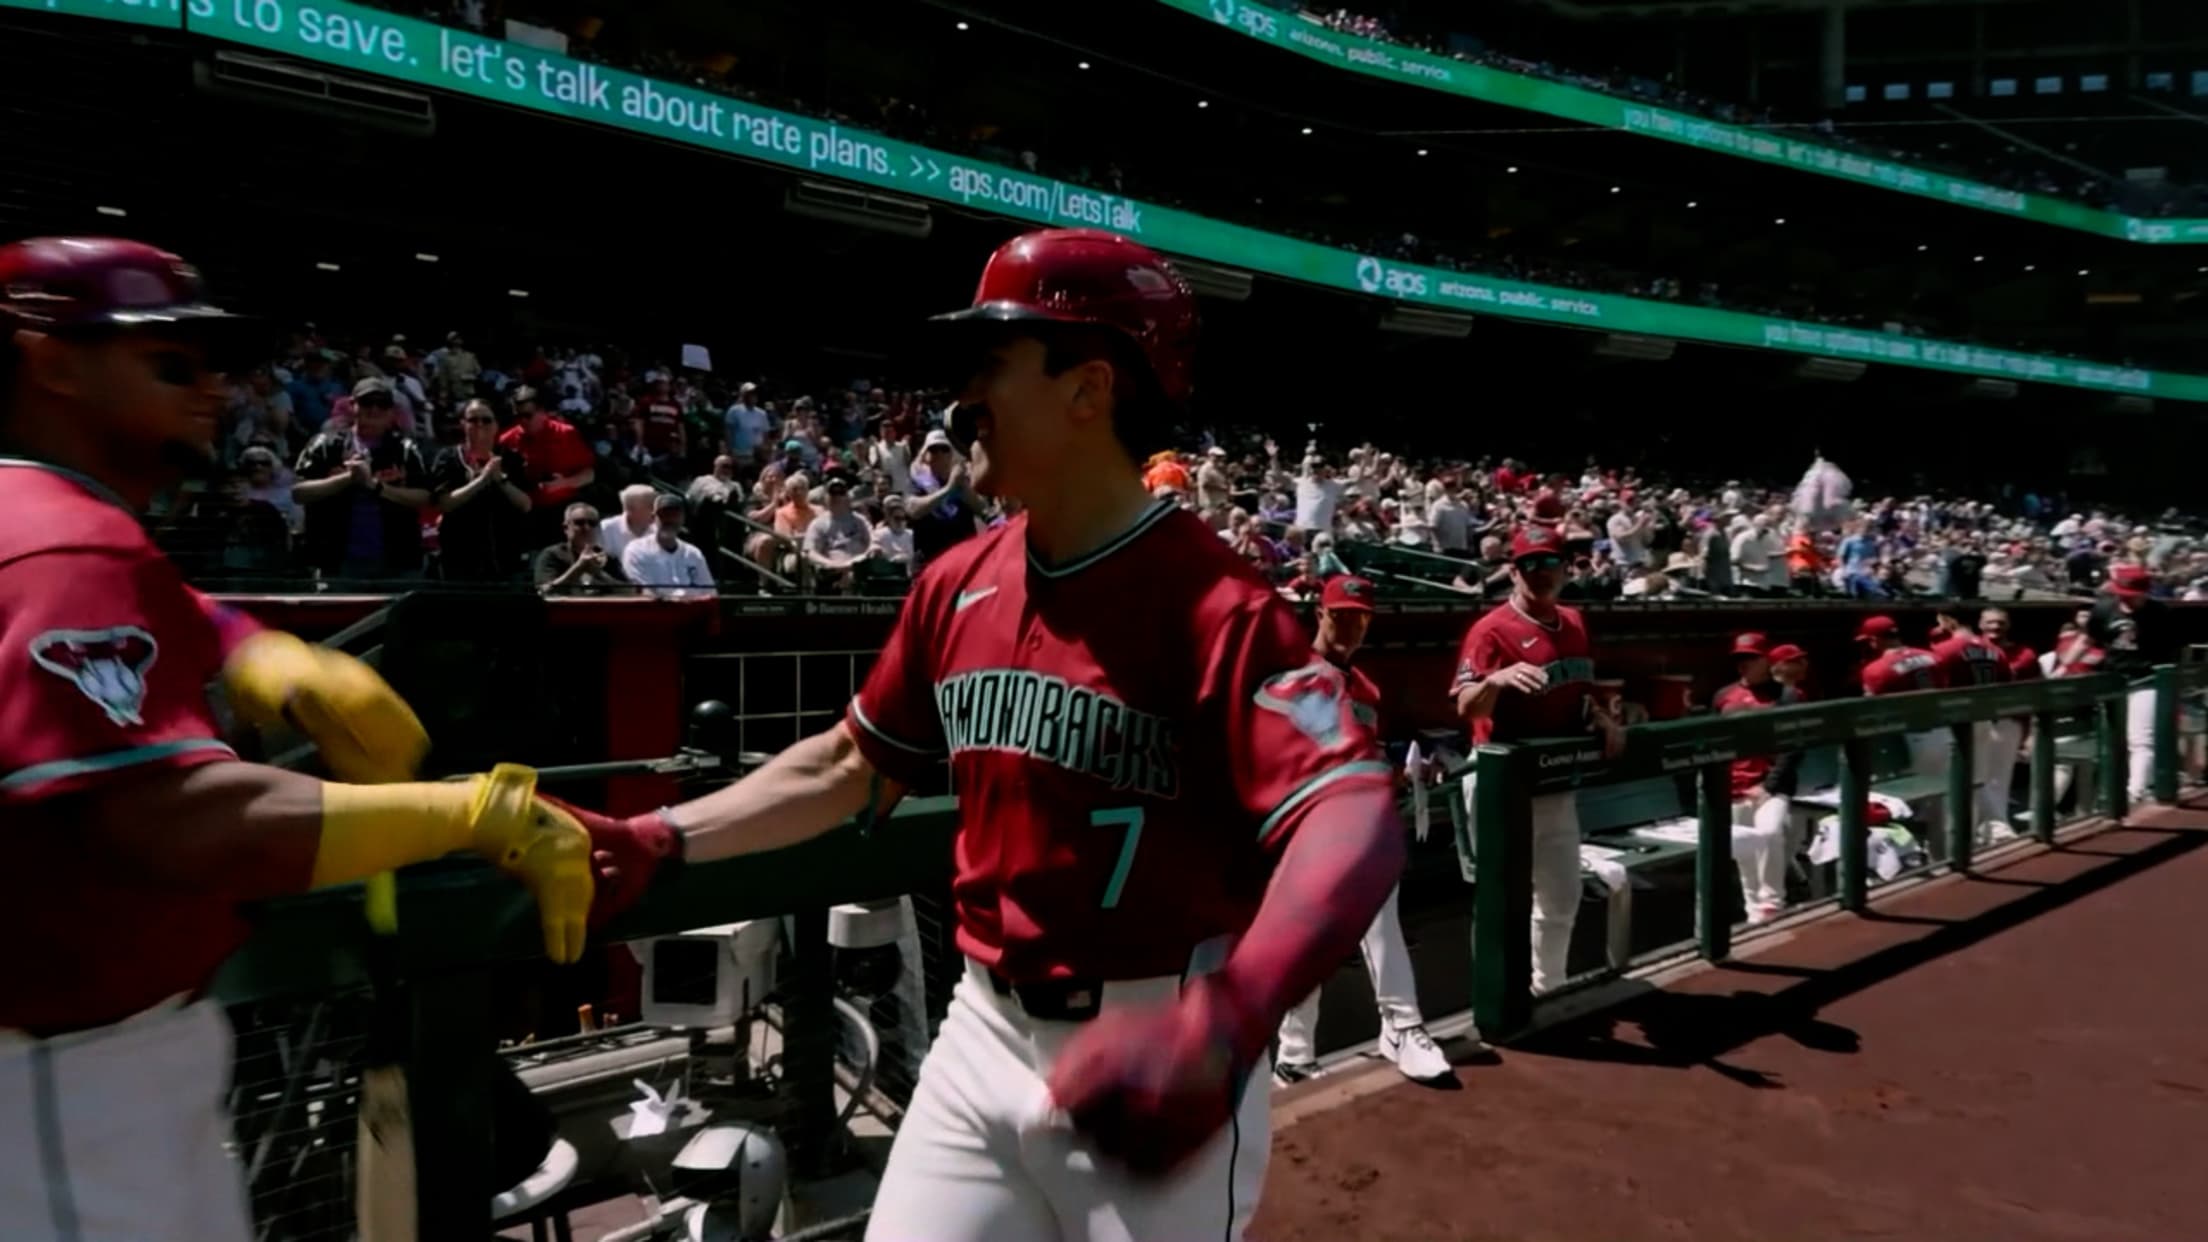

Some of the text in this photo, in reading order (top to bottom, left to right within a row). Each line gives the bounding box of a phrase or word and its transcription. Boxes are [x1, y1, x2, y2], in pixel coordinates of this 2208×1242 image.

[1237, 5, 1278, 38] aps
[298, 7, 418, 67] save.
[440, 28, 527, 90] let's
[536, 58, 612, 111] talk
[621, 78, 724, 137] about
[732, 110, 801, 154] rate
[809, 129, 897, 177] plans.
[949, 164, 1142, 234] aps.com/LetsTalk
[1385, 267, 1428, 298] aps
[1091, 806, 1144, 908] 7
